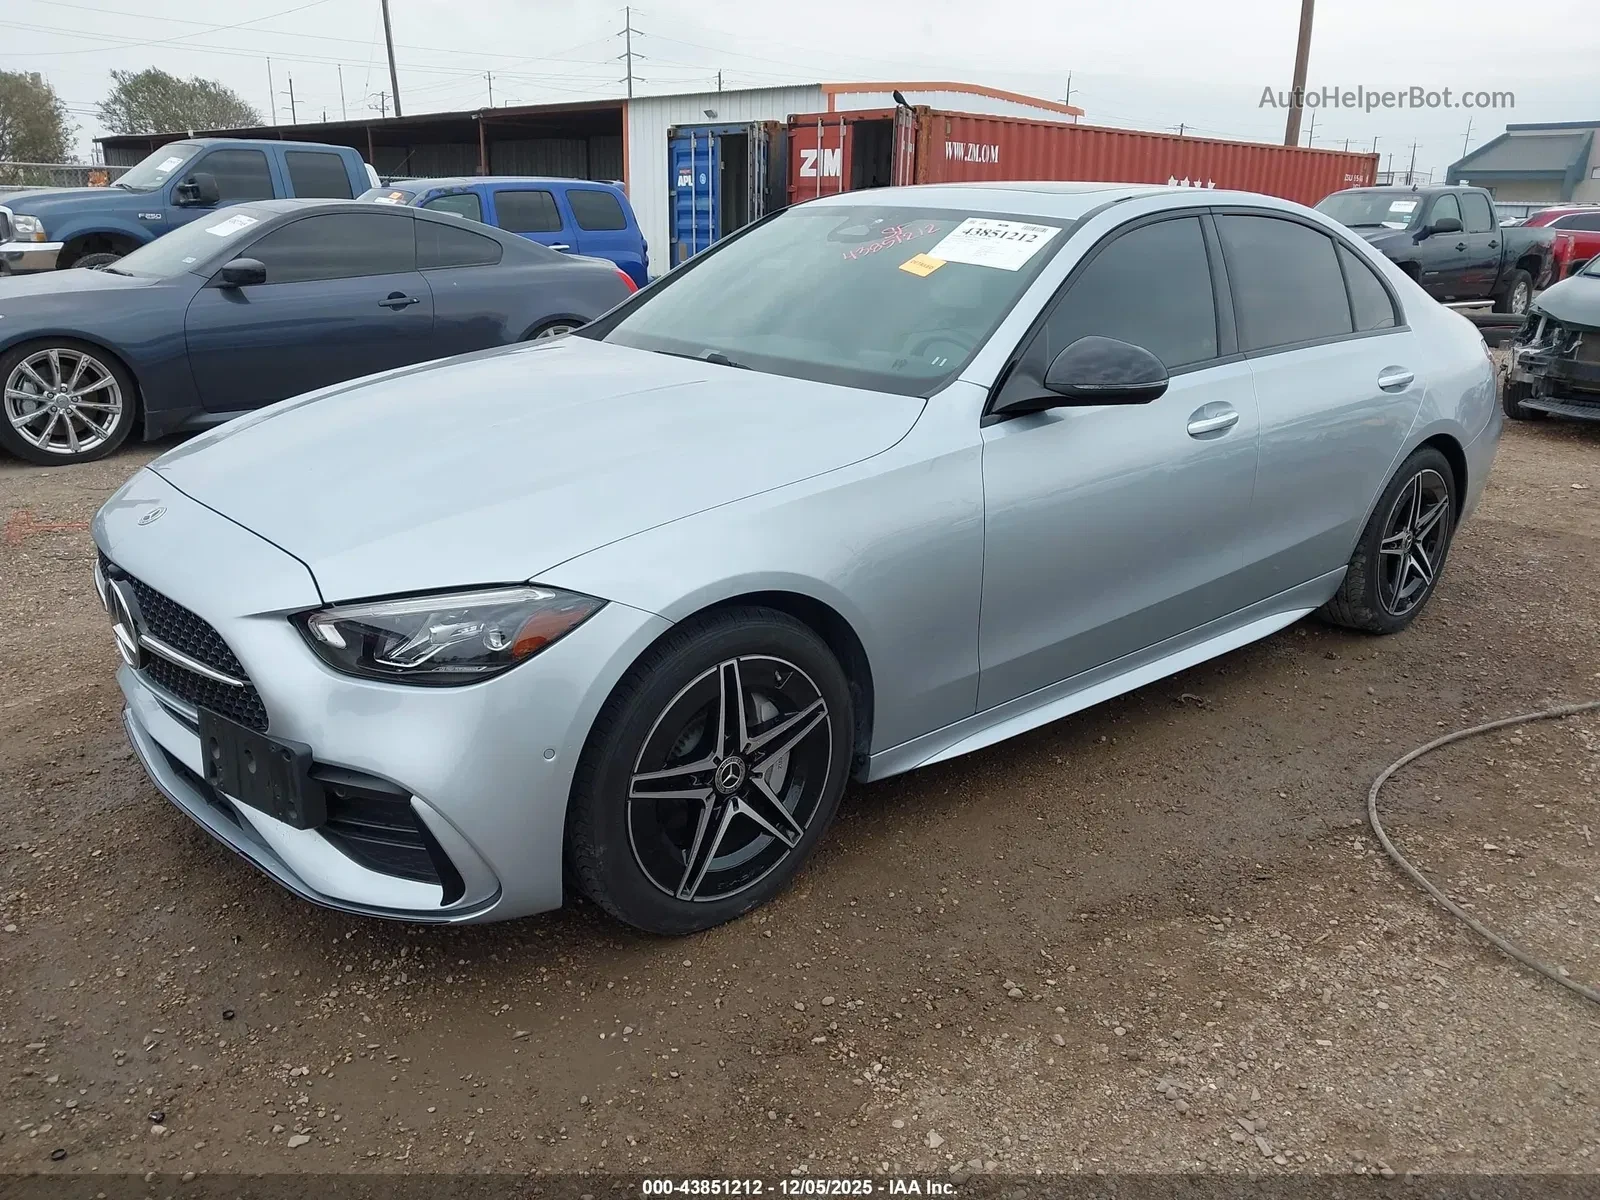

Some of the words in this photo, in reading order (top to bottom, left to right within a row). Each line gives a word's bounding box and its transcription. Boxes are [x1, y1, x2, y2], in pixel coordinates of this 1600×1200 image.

[800, 149, 841, 177] ZIM
[842, 223, 941, 260] 43851212
[962, 227, 1039, 244] 43851212
